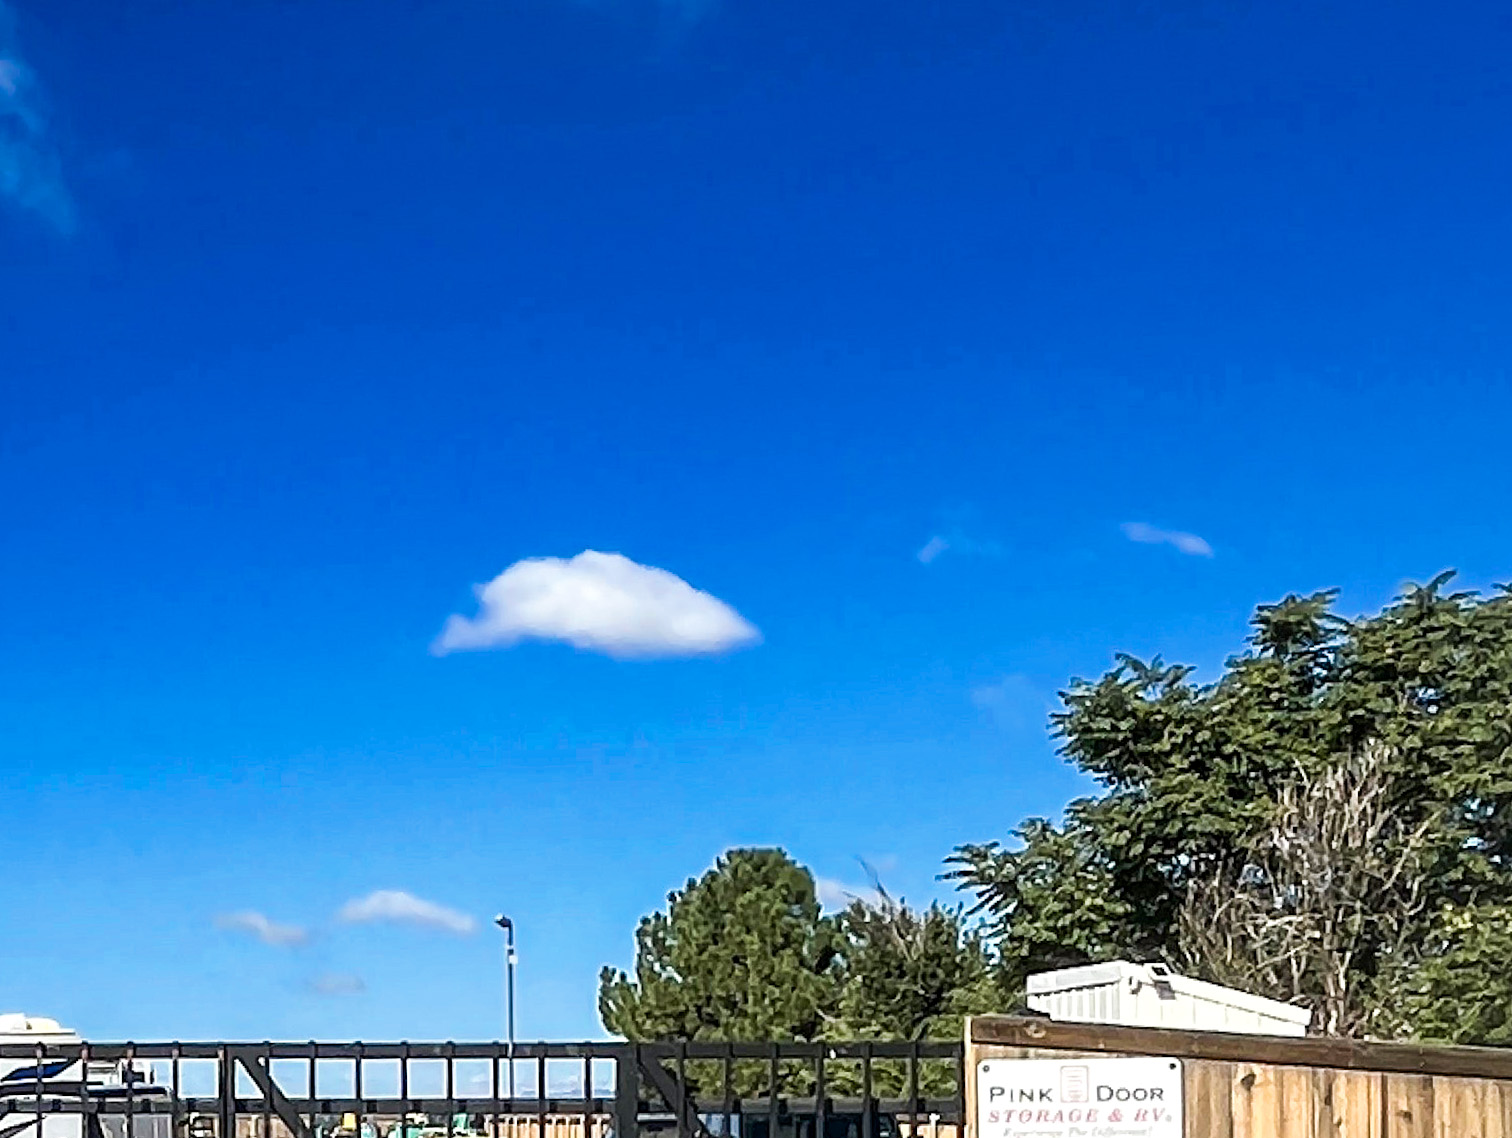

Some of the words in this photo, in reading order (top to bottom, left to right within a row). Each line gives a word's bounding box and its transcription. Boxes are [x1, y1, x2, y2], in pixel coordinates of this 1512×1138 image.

[989, 1086, 1054, 1103] PINK
[1096, 1085, 1164, 1102] DOOR
[988, 1108, 1100, 1123] STORAGE
[1108, 1108, 1123, 1122] &
